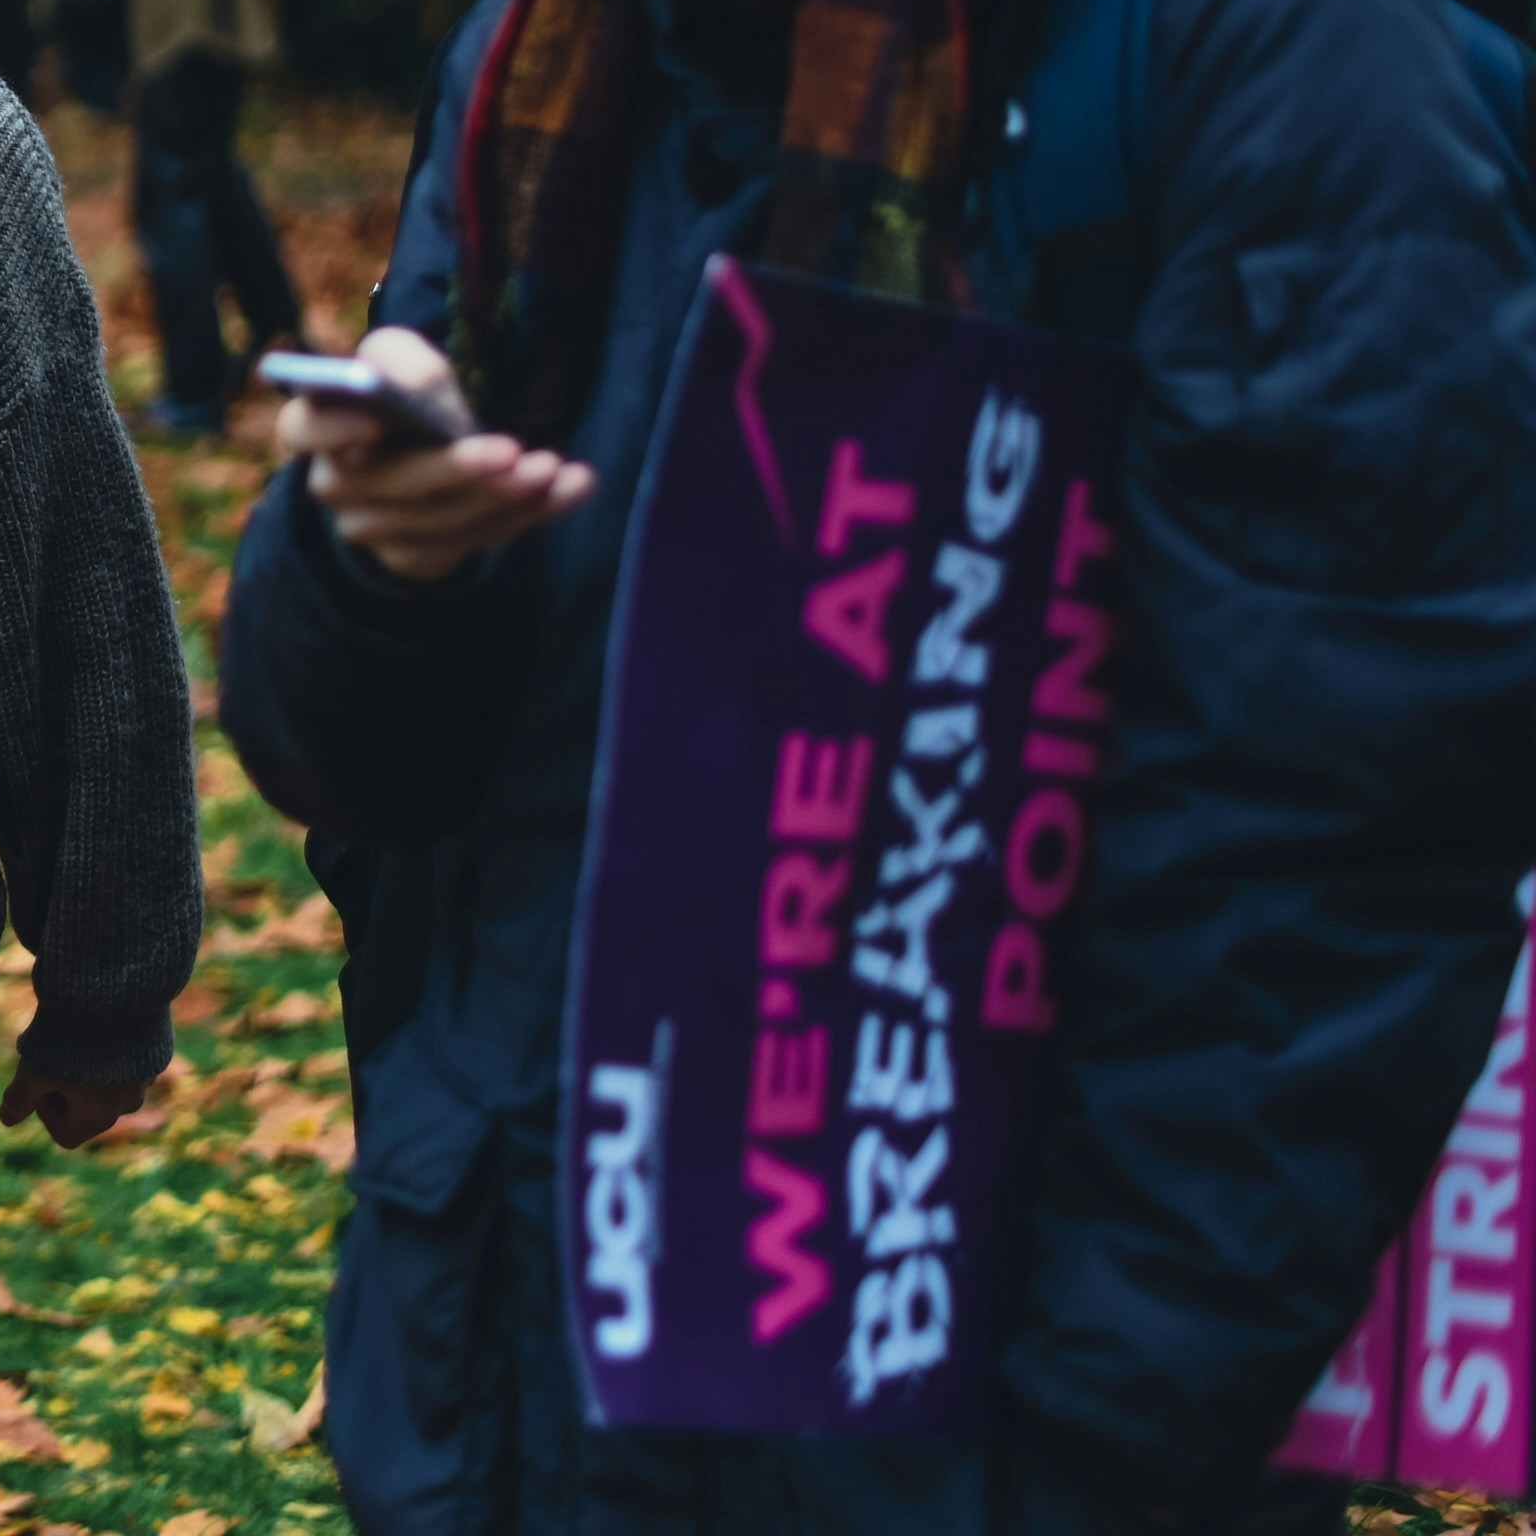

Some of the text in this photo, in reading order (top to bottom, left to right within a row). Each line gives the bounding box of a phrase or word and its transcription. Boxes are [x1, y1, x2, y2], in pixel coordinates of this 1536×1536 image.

[745, 439, 915, 1345] WE'RE AT
[843, 386, 1042, 1402] BREAKING
[982, 479, 1117, 1032] POINT
